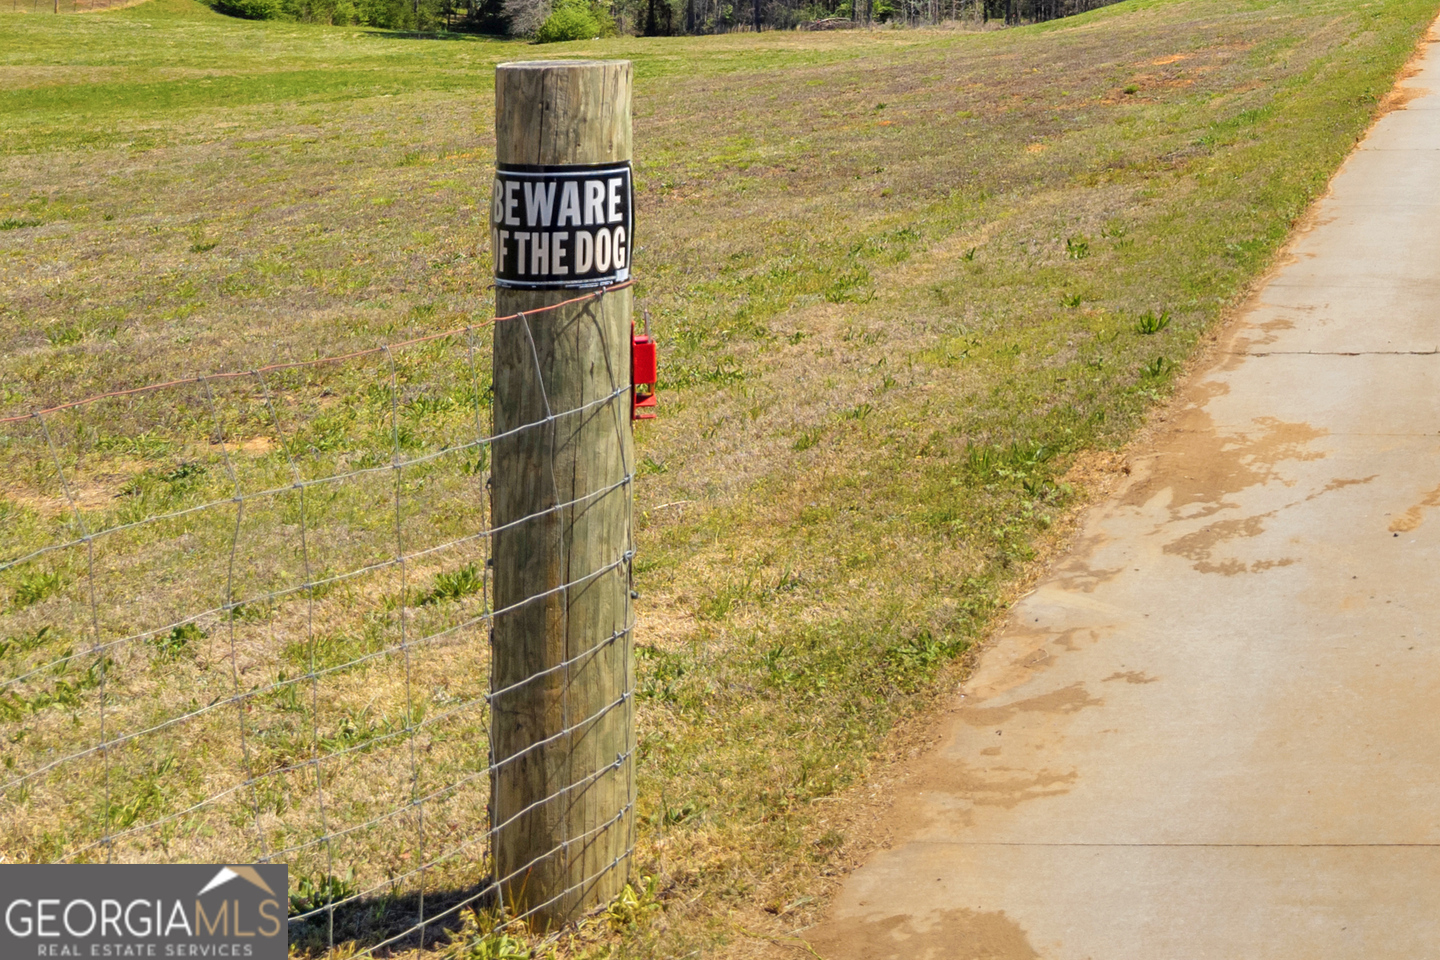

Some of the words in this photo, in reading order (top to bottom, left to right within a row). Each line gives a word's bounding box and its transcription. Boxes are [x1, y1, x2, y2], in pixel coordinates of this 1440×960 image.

[494, 178, 623, 227] BEWARE
[514, 231, 569, 275] THE
[574, 225, 626, 275] DOG
